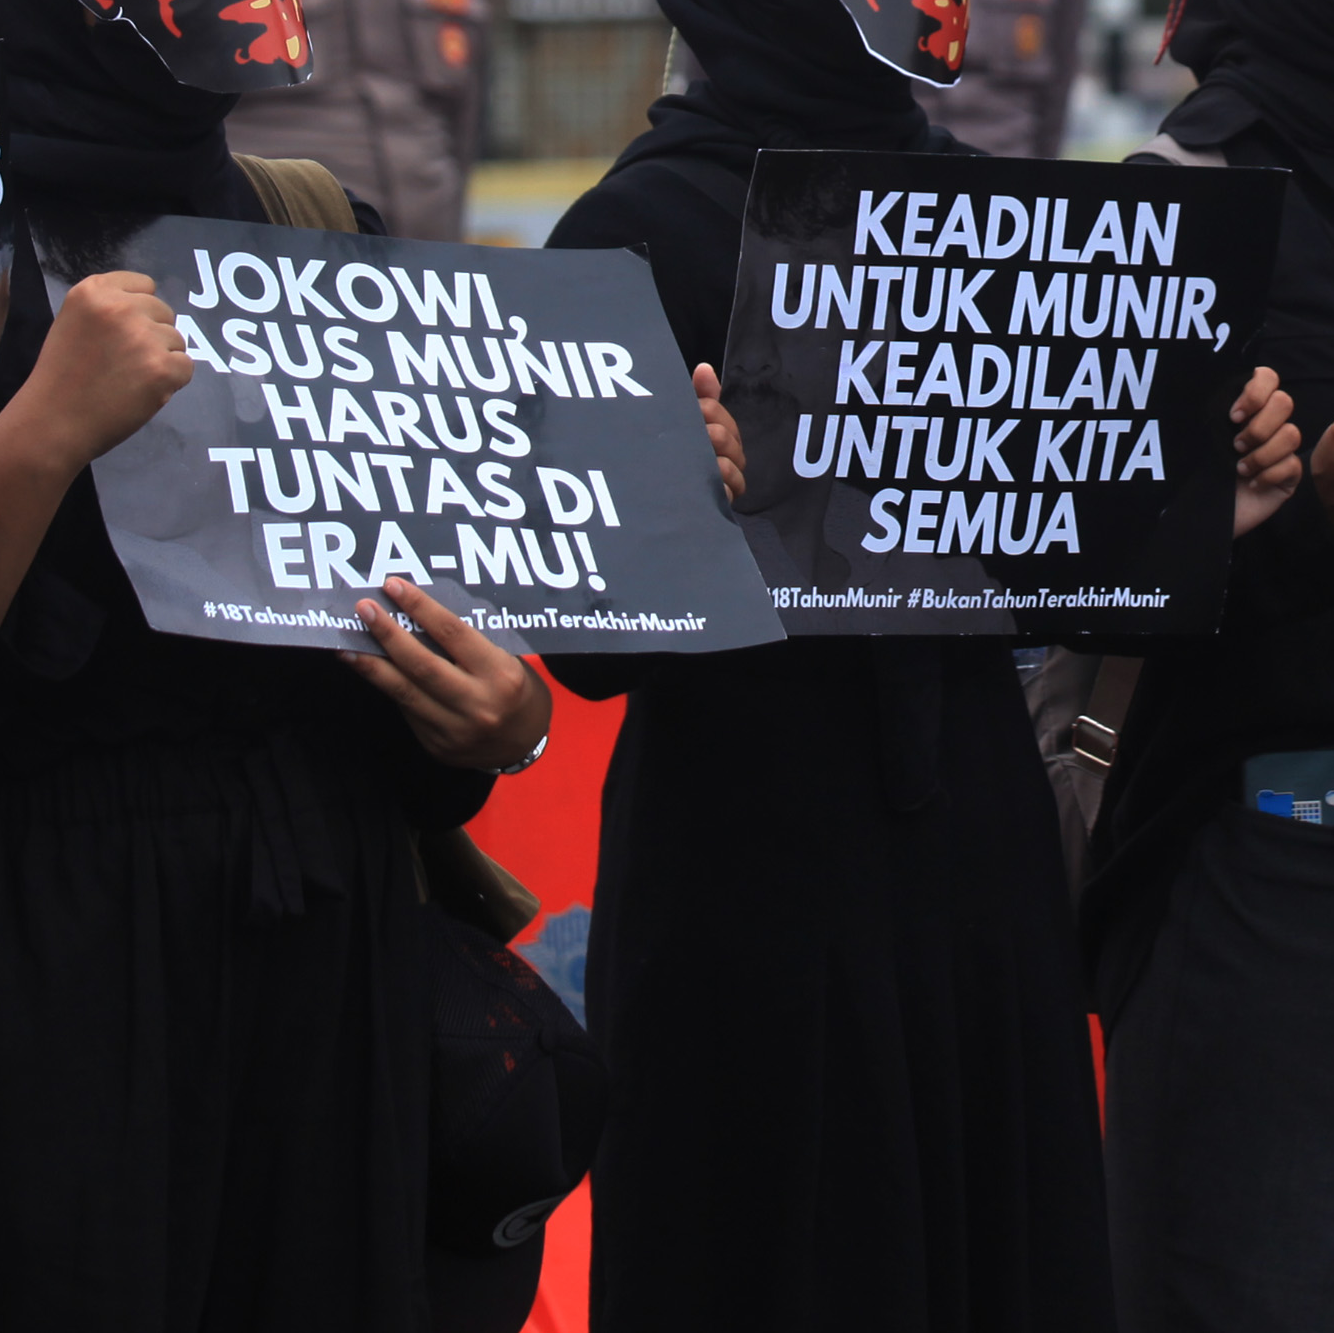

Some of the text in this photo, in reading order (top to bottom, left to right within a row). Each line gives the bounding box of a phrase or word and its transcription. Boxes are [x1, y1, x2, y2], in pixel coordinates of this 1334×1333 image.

[854, 191, 1180, 266] KEADILAN
[188, 249, 529, 338] JOKOWI,
[772, 263, 1229, 352] UNTUK MUNIR,
[174, 314, 653, 398] ASUS MUNIR
[835, 340, 1158, 409] KEADILAN
[261, 383, 531, 457] HARUS
[793, 414, 1165, 482] UNTUK KITA
[208, 448, 620, 526] TUNTAS DI
[861, 488, 1079, 555] SEMUA
[263, 522, 606, 591] ERA-MU!
[203, 601, 369, 632] #18TahunMuni
[767, 587, 1170, 608] 18TahunMunir #BukanTahunTerakhirMunir
